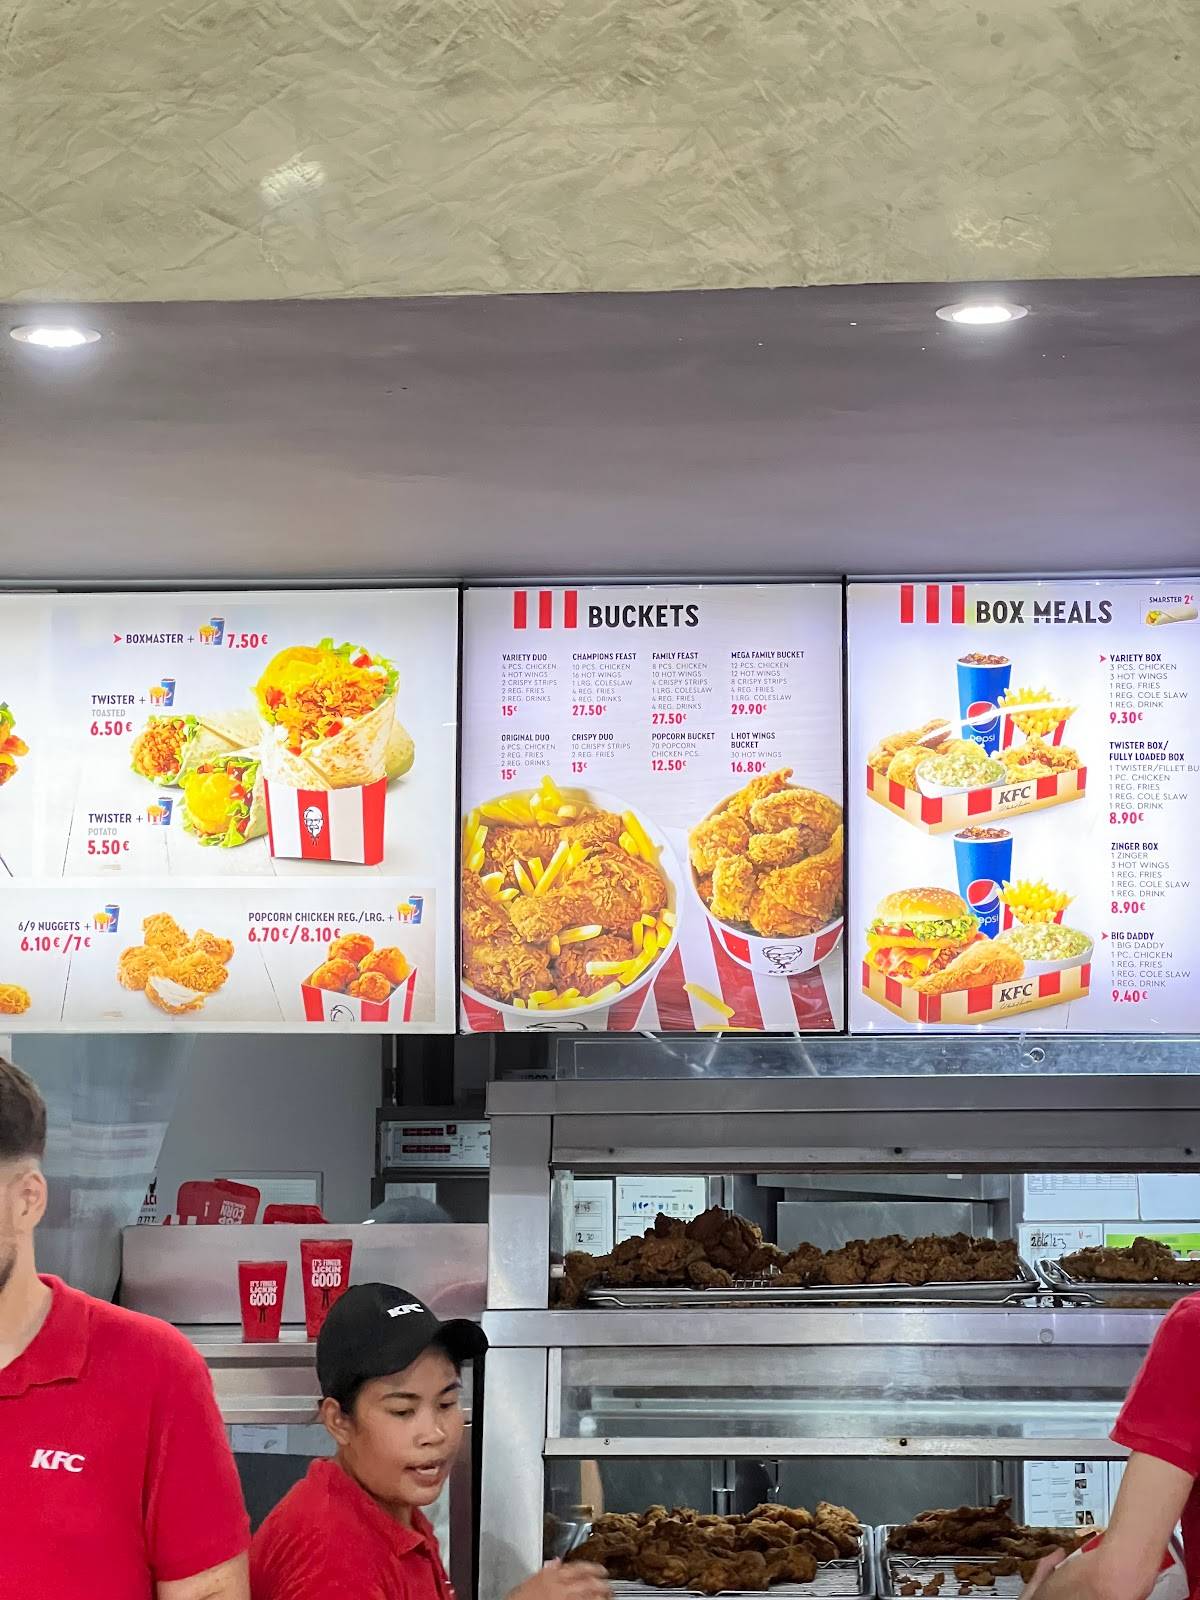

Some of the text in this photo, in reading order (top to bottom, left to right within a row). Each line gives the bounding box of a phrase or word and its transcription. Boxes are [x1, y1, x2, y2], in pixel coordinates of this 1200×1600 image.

[588, 604, 699, 628] BUCKETS
[976, 600, 1113, 624] BOX MEALS
[126, 634, 183, 644] BOXMASTER
[572, 653, 637, 661] CHAMPIONS FEAST
[652, 652, 698, 660] FAMILY FEAST
[731, 651, 804, 659] MEGA FAMILY BUCKET
[1110, 654, 1162, 662] VARIETY BOX
[1117, 663, 1136, 671] PCS.
[1139, 663, 1177, 671] CHICKEN
[1117, 672, 1135, 680] HOT
[1139, 672, 1168, 680] WINGS
[1115, 691, 1135, 699] REG.
[1138, 691, 1161, 699] COLE
[1163, 691, 1188, 699] SLAW
[91, 695, 135, 705] TWISTER
[91, 708, 126, 717] TOASTED
[651, 732, 715, 740] POPCORN BUCKET
[736, 732, 750, 740] HOT
[752, 732, 776, 740] WINGS
[731, 741, 759, 749] BUCKET
[1109, 740, 1169, 751] TWISTER BOX/
[1109, 752, 1185, 761] FULLY LOADED BOX
[1115, 783, 1135, 791] REG.
[1137, 783, 1160, 791] FRIES
[998, 786, 1031, 804] KFC
[88, 813, 132, 823] TWISTER
[88, 828, 117, 836] POTATO
[1111, 842, 1159, 851] ZINGER BOX
[1118, 861, 1137, 869] HOT
[1140, 861, 1170, 869] WINGS
[248, 912, 292, 922] POPCORN
[295, 912, 335, 922] CHICKEN
[337, 911, 385, 923] REG./LRG.
[18, 920, 36, 932] 6/9
[38, 921, 80, 931] NUGGETS
[1111, 932, 1154, 940] BIG DADDY
[1000, 983, 1033, 1002] KFC
[311, 1273, 342, 1287] GOOD
[249, 1293, 277, 1306] GOOD
[387, 1303, 424, 1317] KFC
[30, 1448, 86, 1473] KFC
